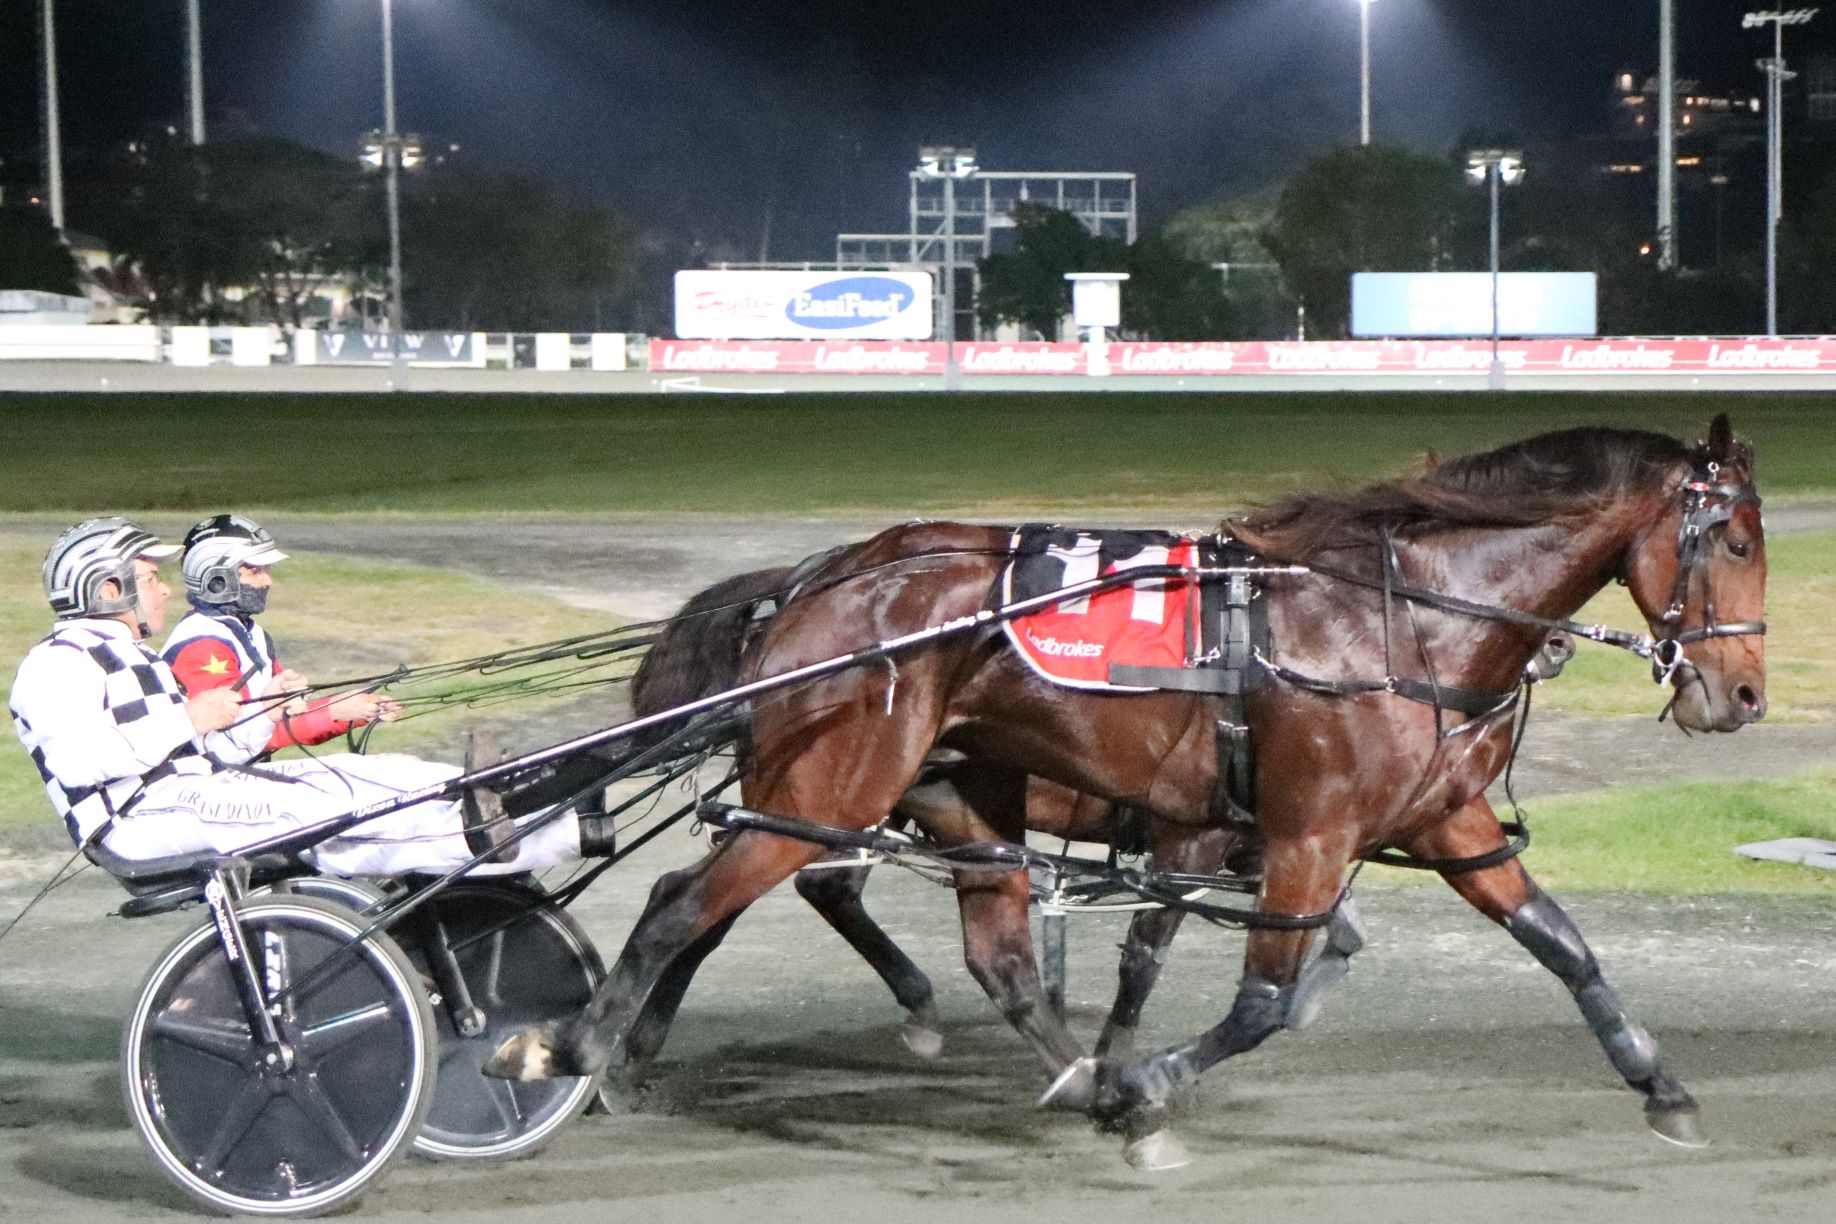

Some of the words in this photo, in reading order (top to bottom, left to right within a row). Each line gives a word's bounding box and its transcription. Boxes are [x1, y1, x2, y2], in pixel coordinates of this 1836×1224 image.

[794, 293, 904, 317] EasiFeed
[362, 334, 425, 349] VIW
[662, 345, 780, 369] Ladbrokes
[814, 346, 930, 370] Ladbrokes
[962, 347, 1077, 370] Ladbrokes
[1122, 347, 1235, 371] Ladbrokes
[1561, 345, 1674, 368] Ladbrokes
[1708, 345, 1822, 368] Ladbrokes
[1046, 537, 1171, 625] 11
[1026, 627, 1105, 658] Ladbrokes
